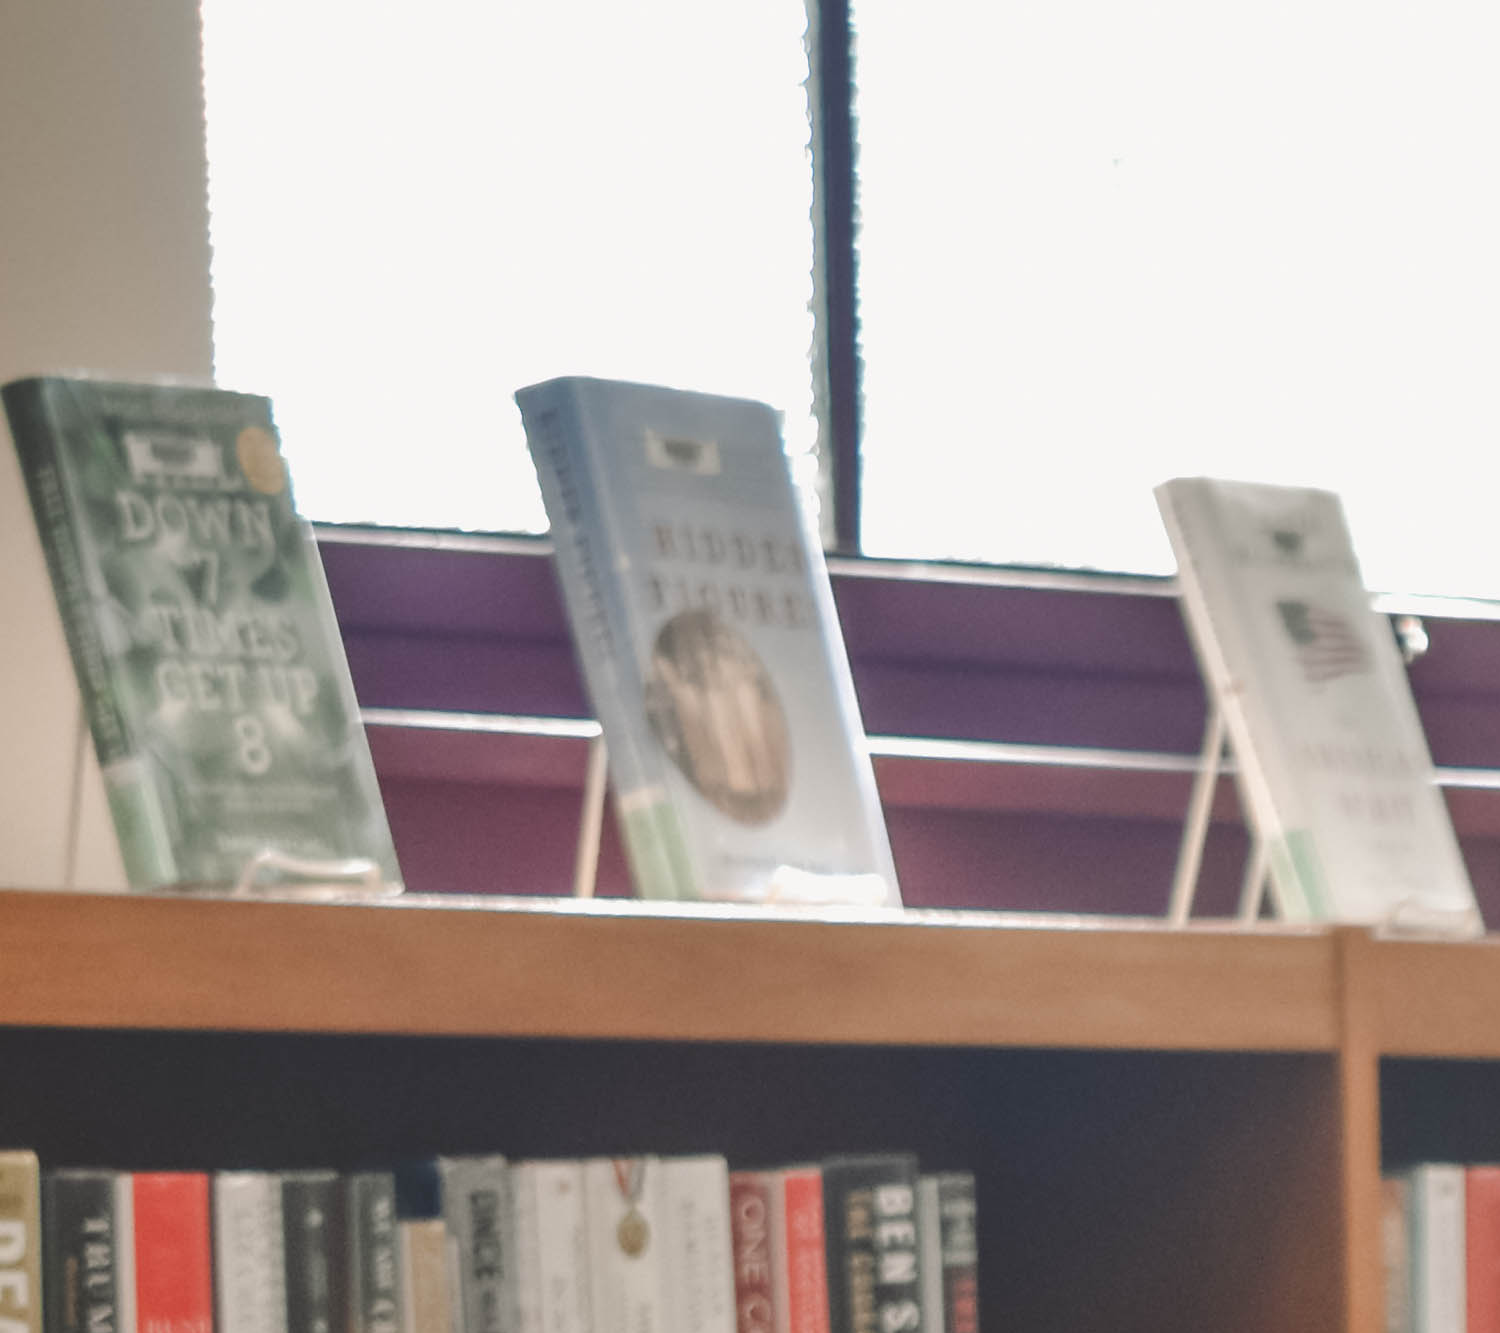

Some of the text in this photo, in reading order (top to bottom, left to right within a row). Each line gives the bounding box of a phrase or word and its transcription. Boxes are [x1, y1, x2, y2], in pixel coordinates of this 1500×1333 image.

[116, 490, 276, 553] DOWN
[148, 603, 301, 664] TIMES
[155, 659, 321, 716] GET UP
[233, 714, 273, 776] 8
[741, 1197, 770, 1283] ONE
[873, 1183, 918, 1285] BEN
